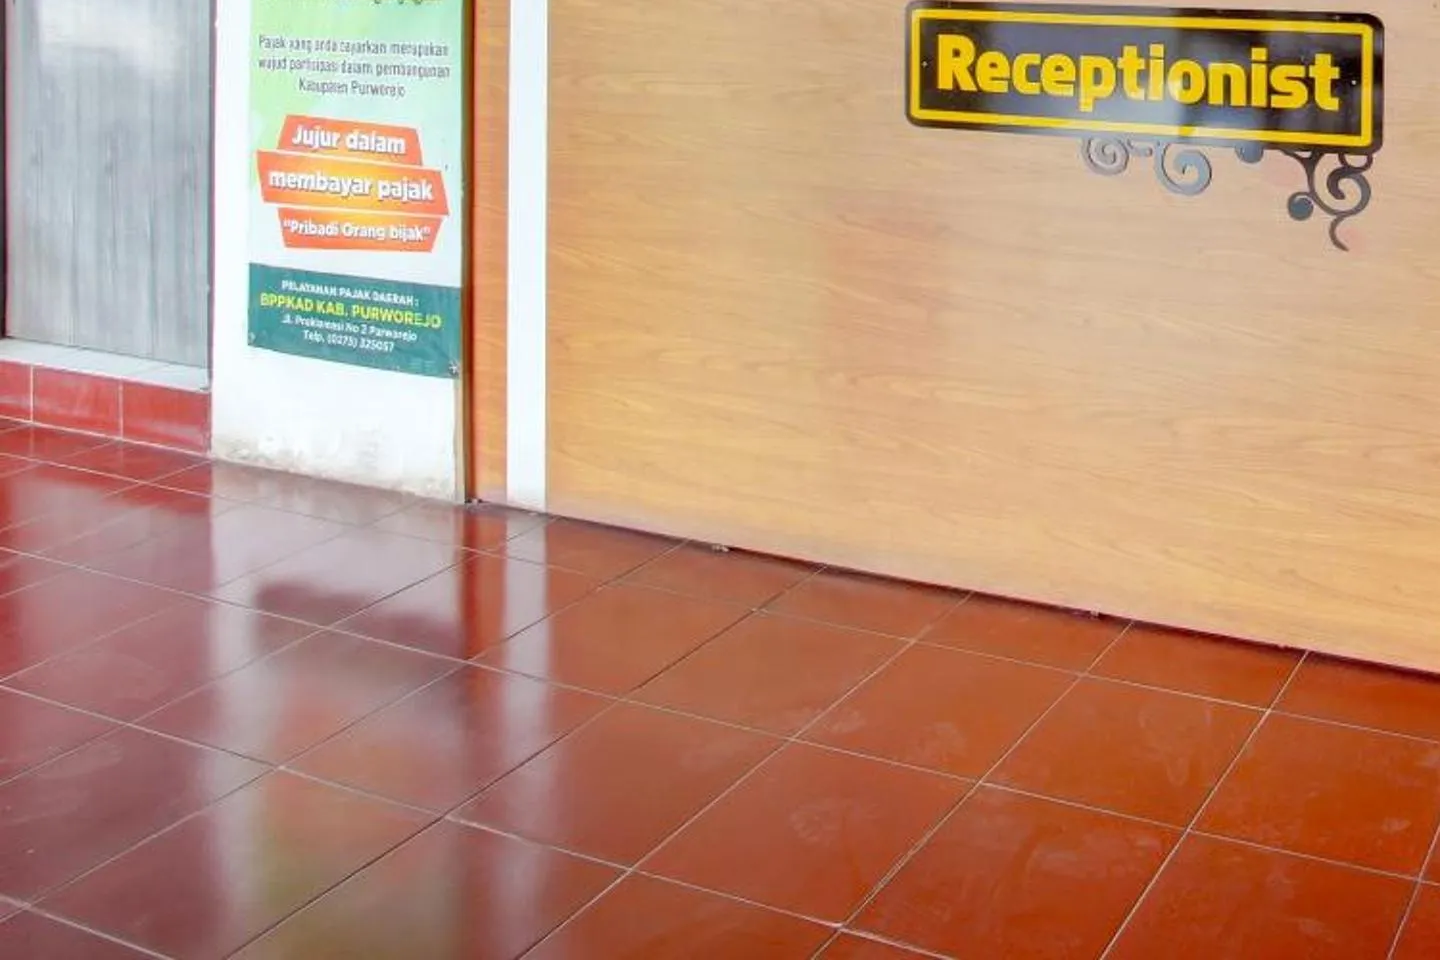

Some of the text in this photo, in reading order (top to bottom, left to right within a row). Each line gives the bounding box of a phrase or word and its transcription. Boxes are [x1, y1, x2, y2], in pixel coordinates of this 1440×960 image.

[299, 77, 406, 97] Kabupaten Purworejo
[936, 33, 1341, 113] Receptionist
[292, 125, 406, 154] Jujur dalam
[268, 169, 433, 202] membayar pajak
[342, 222, 385, 240] Orang
[281, 280, 337, 296] PELAYANAN
[339, 286, 371, 301] PAJAK
[260, 293, 441, 329] BPPKAD KAB. PURWOREJO
